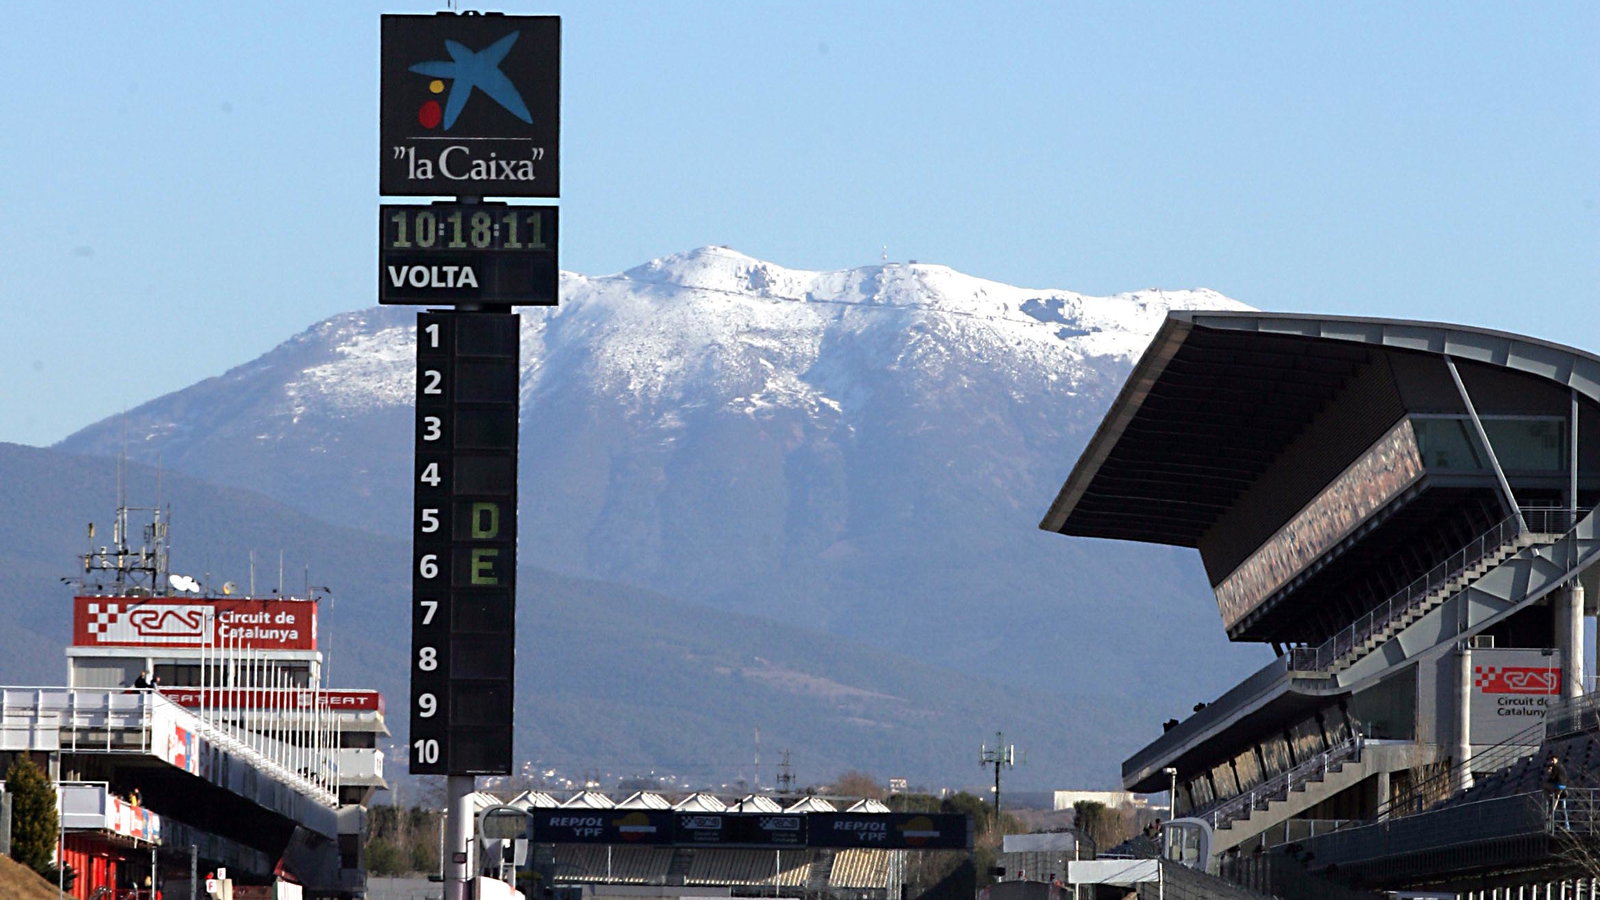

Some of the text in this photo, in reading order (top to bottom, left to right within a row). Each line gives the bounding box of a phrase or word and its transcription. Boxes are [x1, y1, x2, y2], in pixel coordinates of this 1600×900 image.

[392, 210, 546, 249] 10:18:11
[388, 266, 478, 288] VOLTA
[425, 323, 439, 347] 1
[423, 370, 442, 394] 2
[423, 416, 441, 441] 3
[420, 462, 441, 486] 4
[421, 509, 440, 533] 5
[471, 502, 499, 539] D
[419, 554, 439, 578] 6
[471, 548, 499, 584] E
[219, 611, 295, 624] Circuit de
[420, 601, 438, 625] 7
[218, 625, 298, 642] Catalunya
[418, 647, 438, 671] 8
[163, 694, 206, 702] EAT
[318, 696, 369, 705] SEAT
[418, 693, 437, 718] 9
[1497, 697, 1534, 706] Circuit
[414, 739, 439, 764] 10
[549, 817, 603, 826] REPSOL
[573, 828, 603, 836] YPF
[833, 821, 887, 830] REPSOL
[858, 832, 887, 840] YPF
